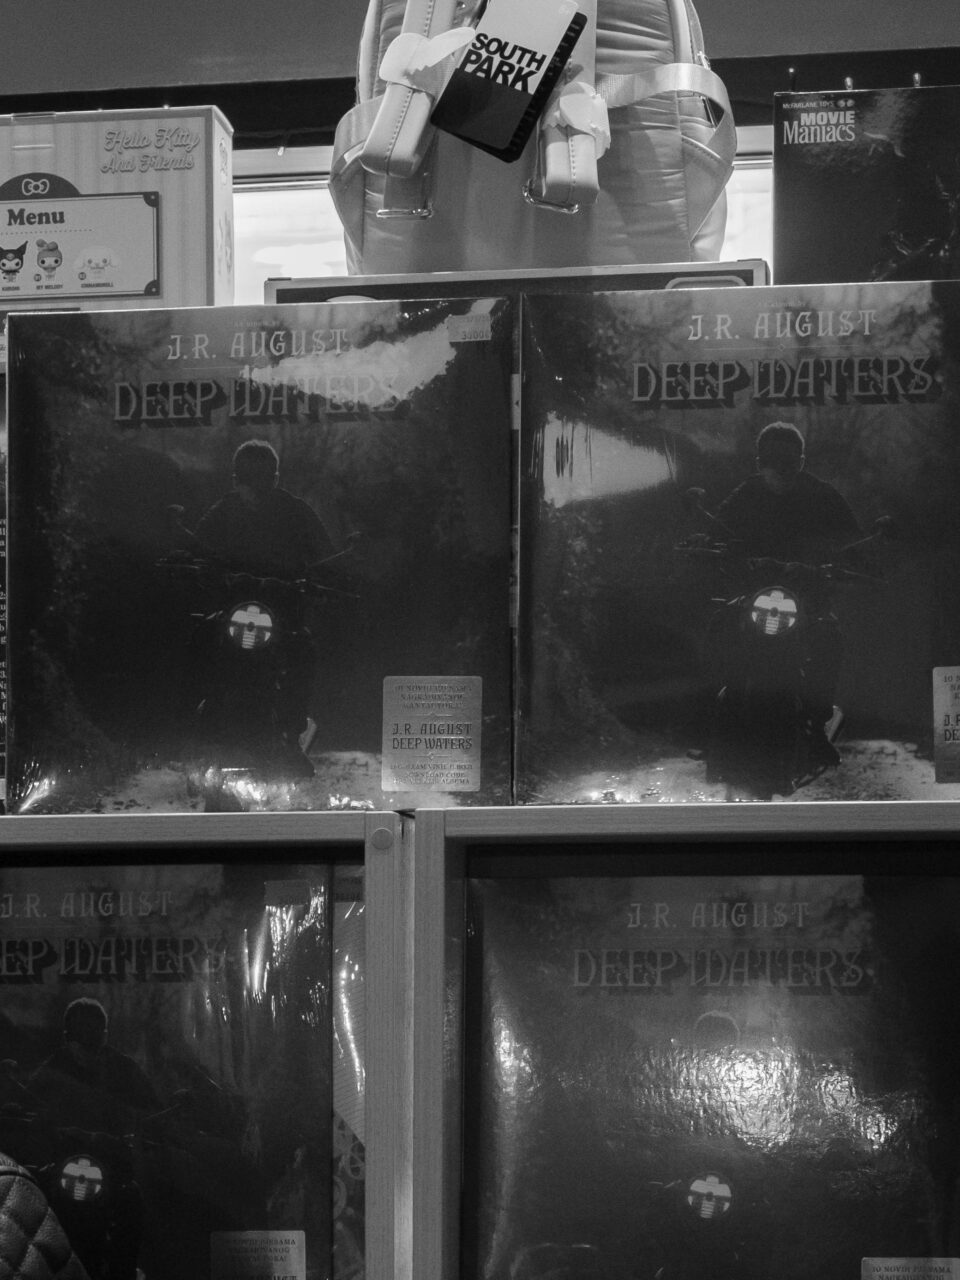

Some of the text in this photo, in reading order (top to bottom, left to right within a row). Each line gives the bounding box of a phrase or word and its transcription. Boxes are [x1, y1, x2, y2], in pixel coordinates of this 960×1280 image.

[471, 33, 548, 71] SOUTH
[458, 49, 539, 94] PARK
[783, 120, 856, 145] Maniacs
[800, 110, 856, 126] MOVIE
[104, 127, 200, 153] Hello Kitty
[101, 153, 195, 174] And Friends
[7, 208, 66, 226] Menu
[688, 310, 877, 341] J.R. AUGUST
[167, 329, 349, 361] J.R. AUGUST
[631, 354, 934, 401] DEEP WATERS
[113, 373, 401, 421] DEEP WATERS
[392, 737, 473, 750] DEEP WATERS
[420, 723, 473, 735] AUGUST
[0, 890, 175, 920] J.R. AUGUST
[626, 901, 811, 929] J.R. AUGUST
[573, 947, 867, 987] DEEP WATERS
